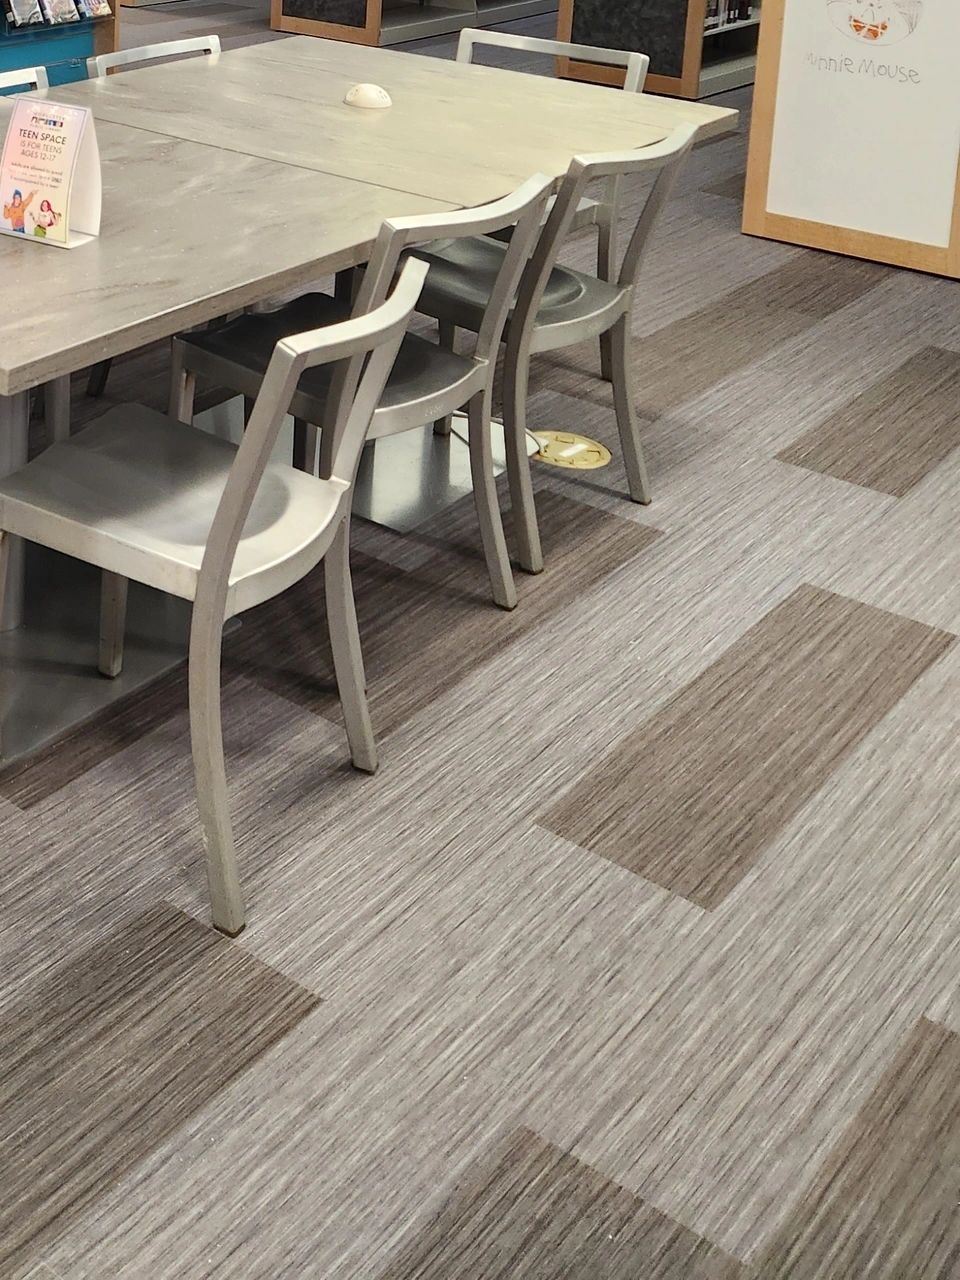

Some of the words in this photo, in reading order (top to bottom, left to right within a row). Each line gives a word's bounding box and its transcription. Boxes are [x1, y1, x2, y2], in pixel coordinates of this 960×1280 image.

[859, 59, 921, 84] Mouse
[19, 128, 39, 140] TEEN
[40, 132, 67, 145] SPACE
[20, 149, 39, 160] AGES
[27, 141, 41, 150] FOR
[42, 144, 62, 154] TEENS
